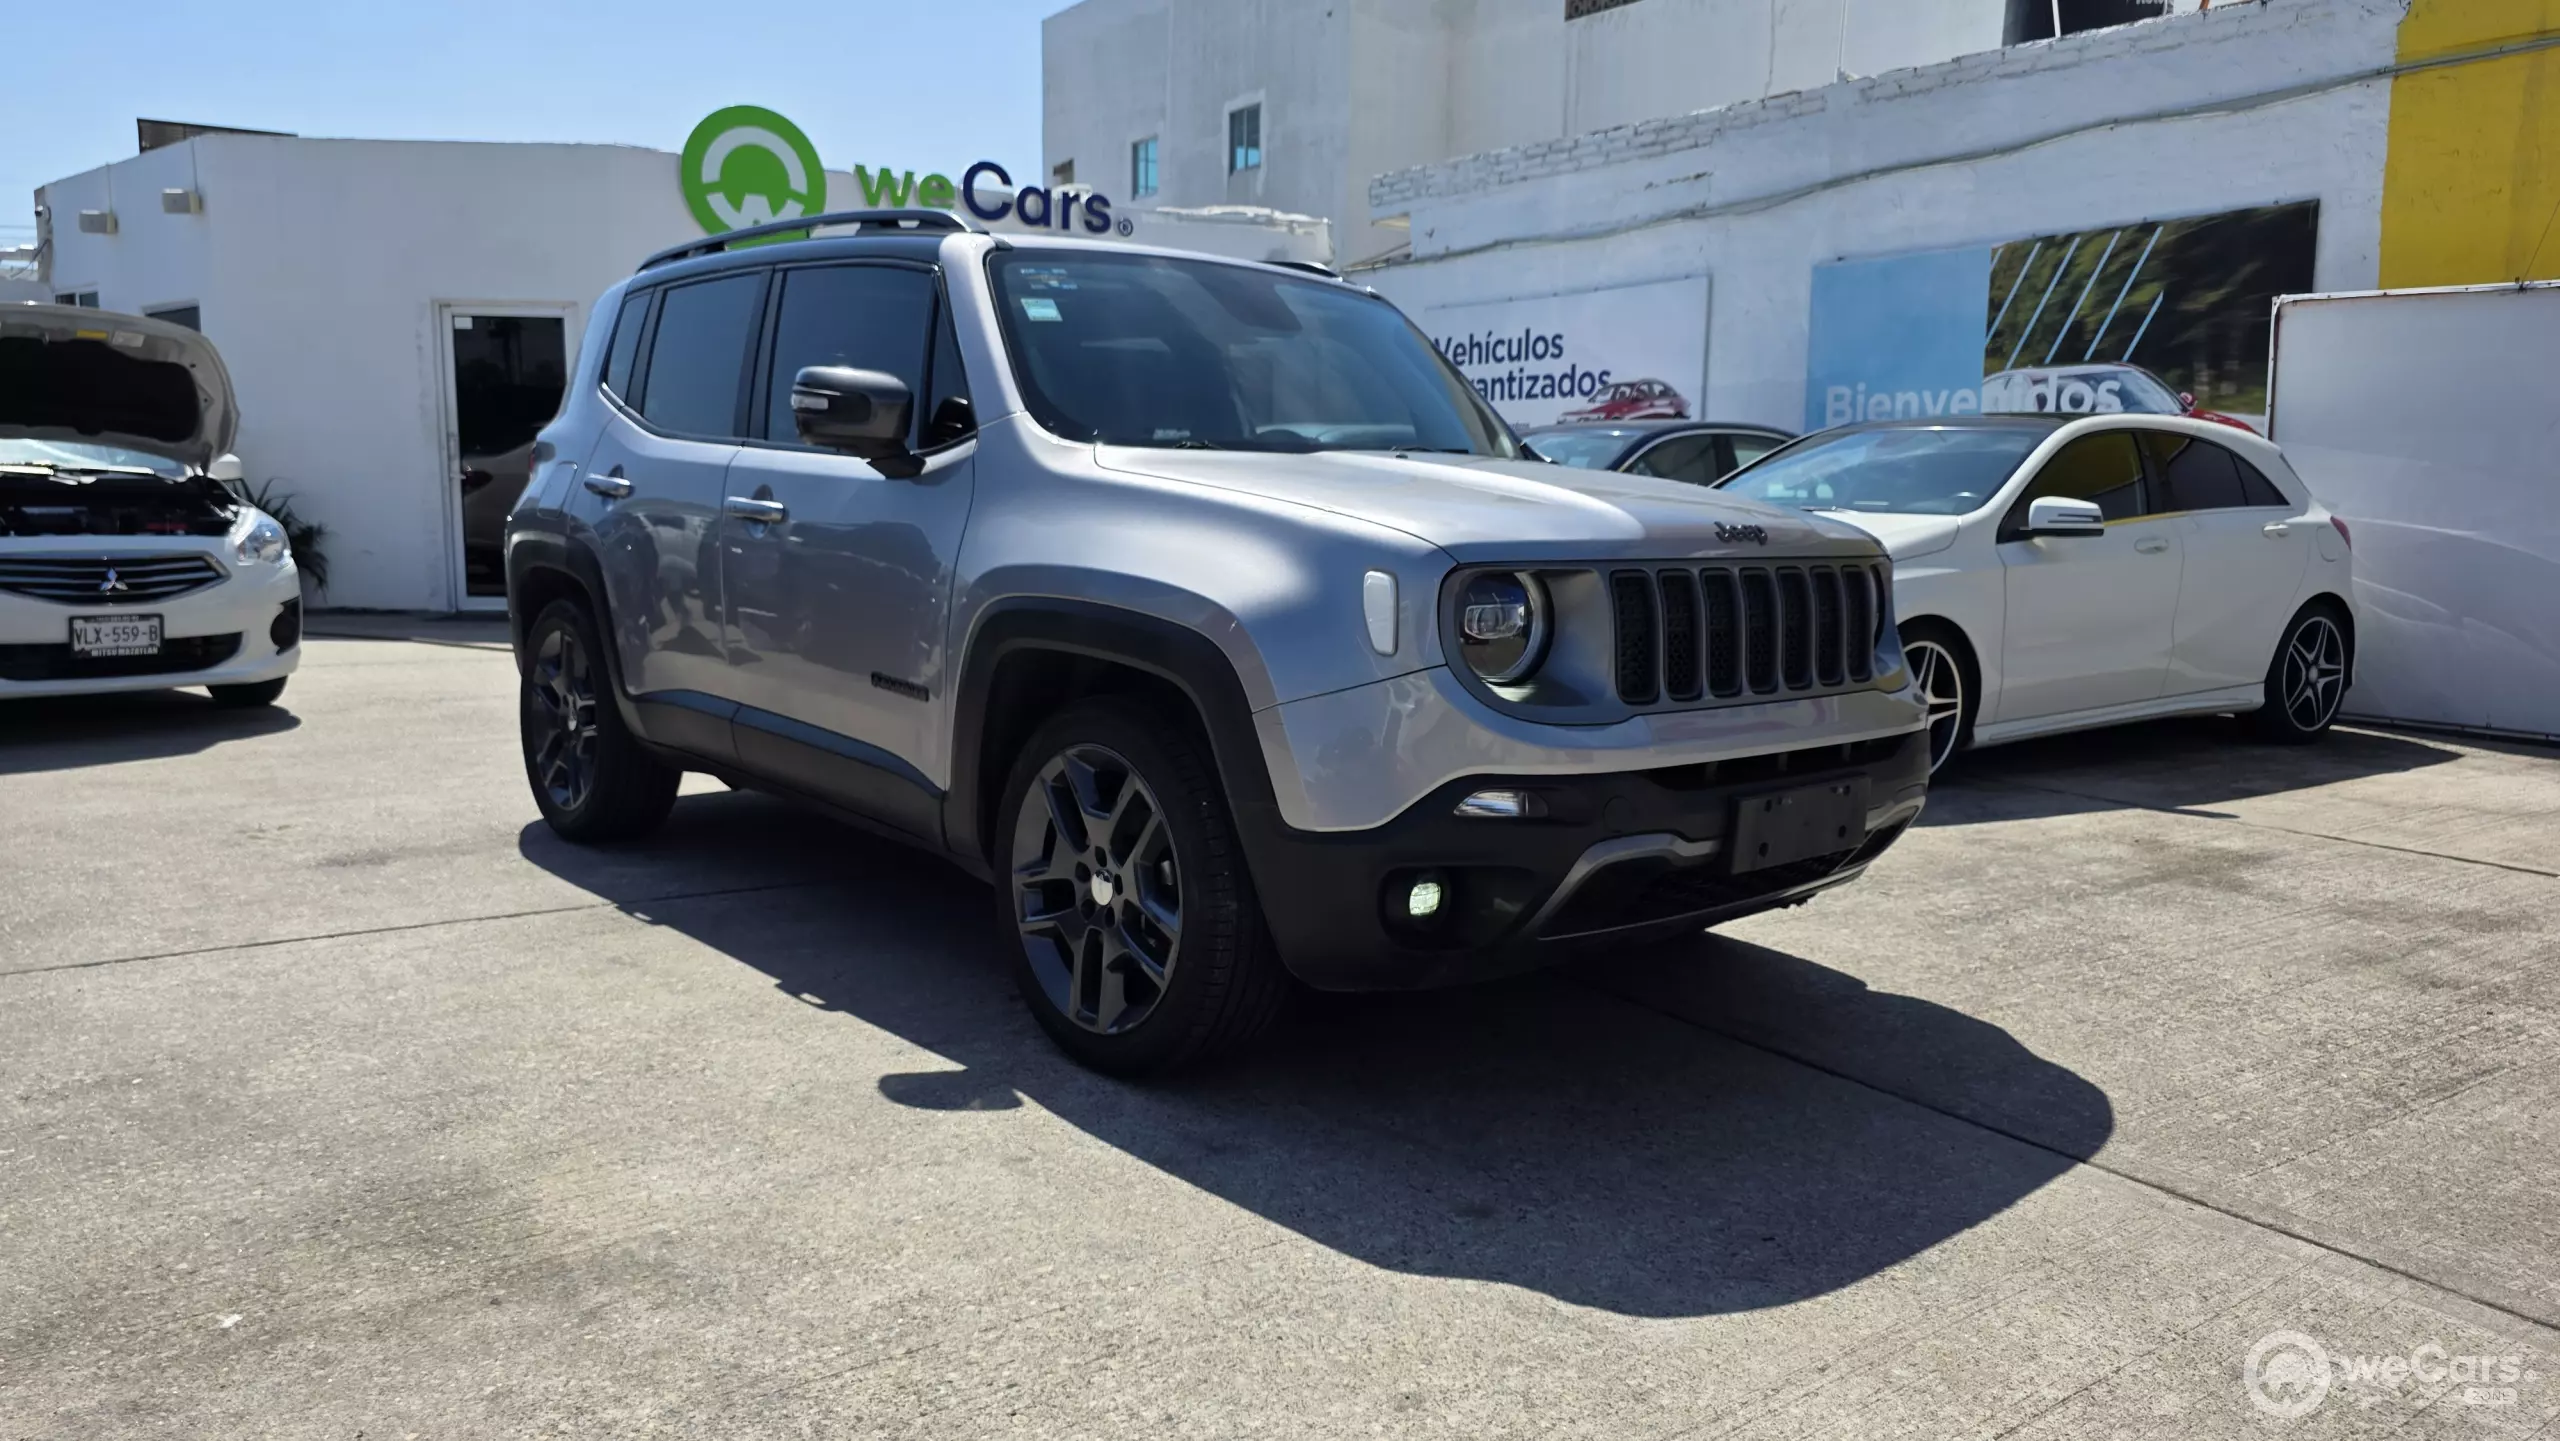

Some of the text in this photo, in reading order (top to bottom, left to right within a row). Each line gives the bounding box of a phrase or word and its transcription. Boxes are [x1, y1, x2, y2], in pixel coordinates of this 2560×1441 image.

[1434, 329, 1564, 367] Vehículos
[1471, 363, 1612, 402] antizados
[1714, 520, 1768, 547] Jeep
